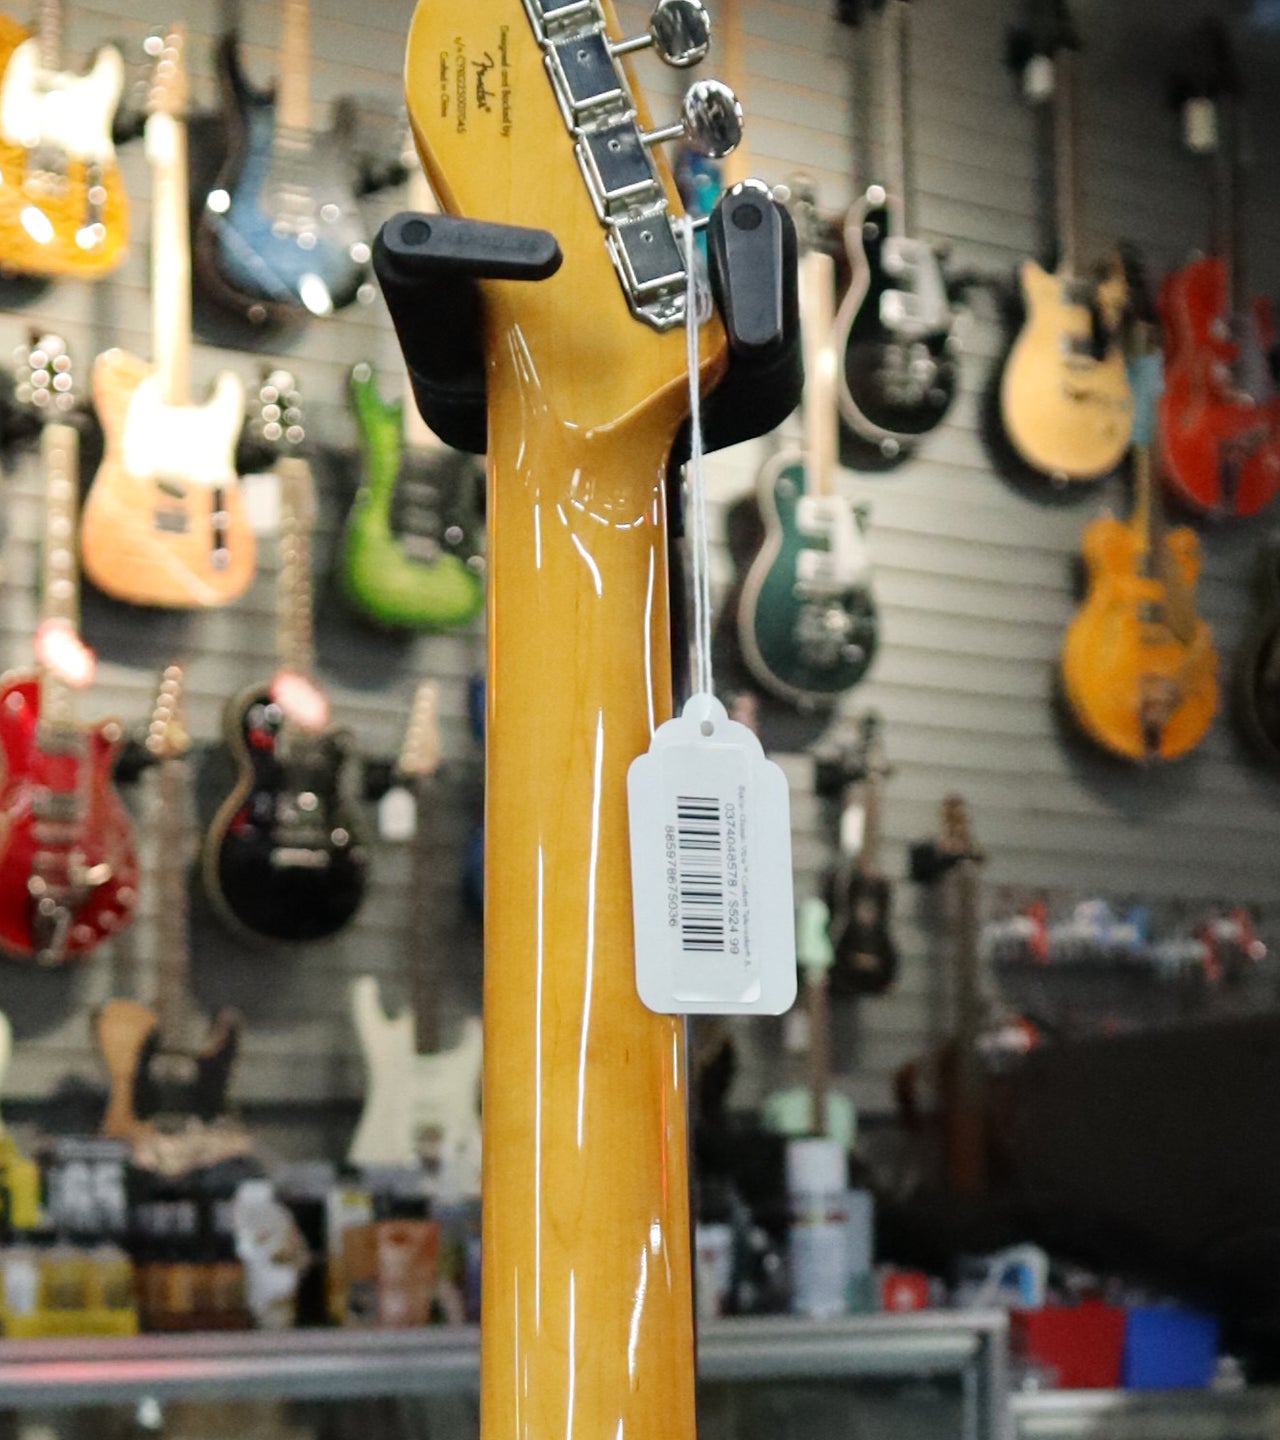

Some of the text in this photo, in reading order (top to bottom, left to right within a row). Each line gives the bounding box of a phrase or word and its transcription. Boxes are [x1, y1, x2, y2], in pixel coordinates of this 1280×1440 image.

[499, 126, 512, 140] by
[664, 824, 679, 928] 885978675036
[724, 803, 739, 888] 0374048578
